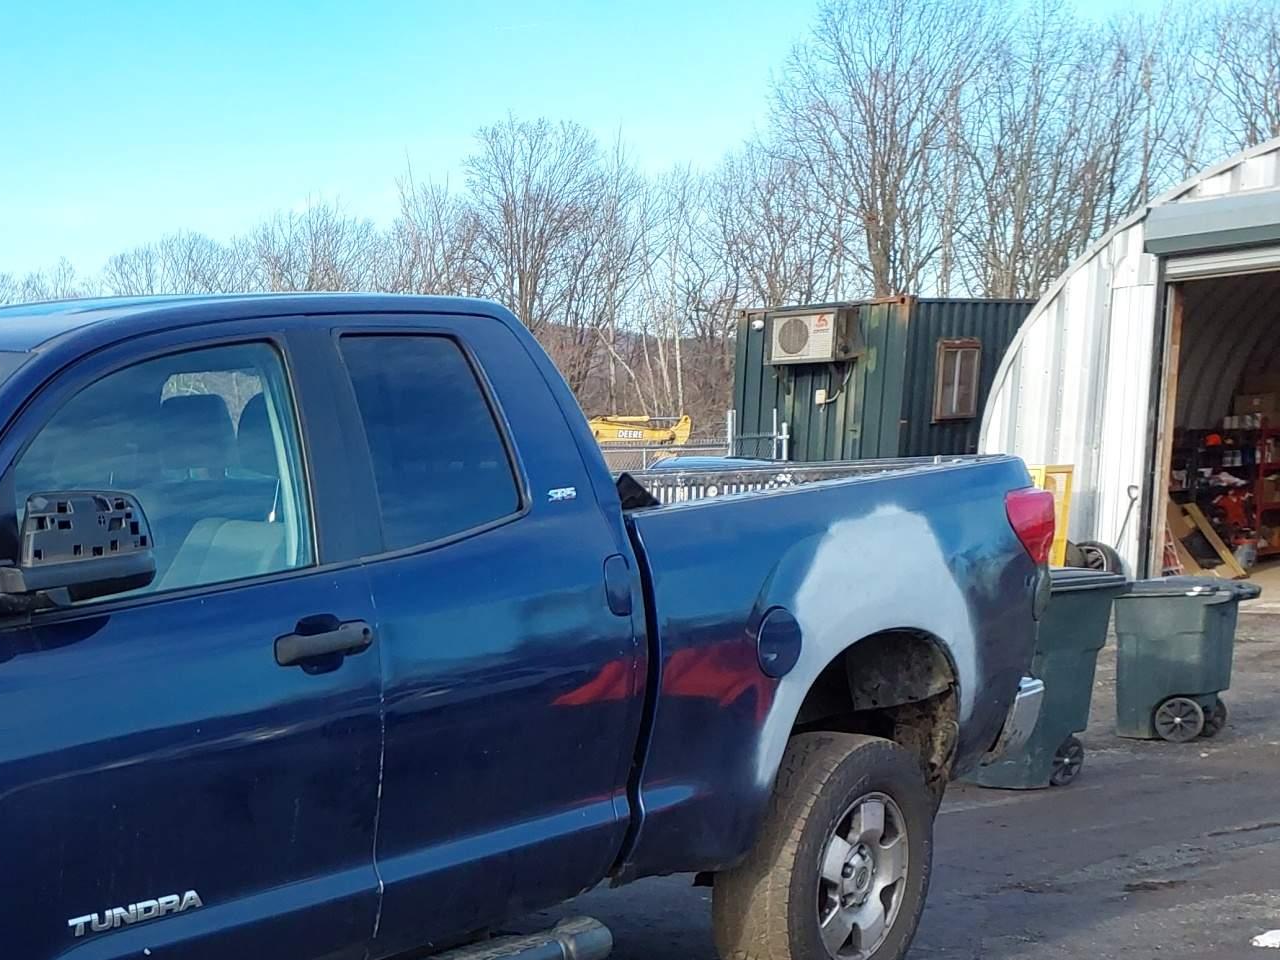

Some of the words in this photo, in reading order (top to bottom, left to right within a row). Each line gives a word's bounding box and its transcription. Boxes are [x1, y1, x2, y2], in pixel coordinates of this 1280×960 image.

[617, 430, 643, 439] DEERE
[548, 487, 576, 502] SR5
[67, 889, 204, 937] TUNDRA
